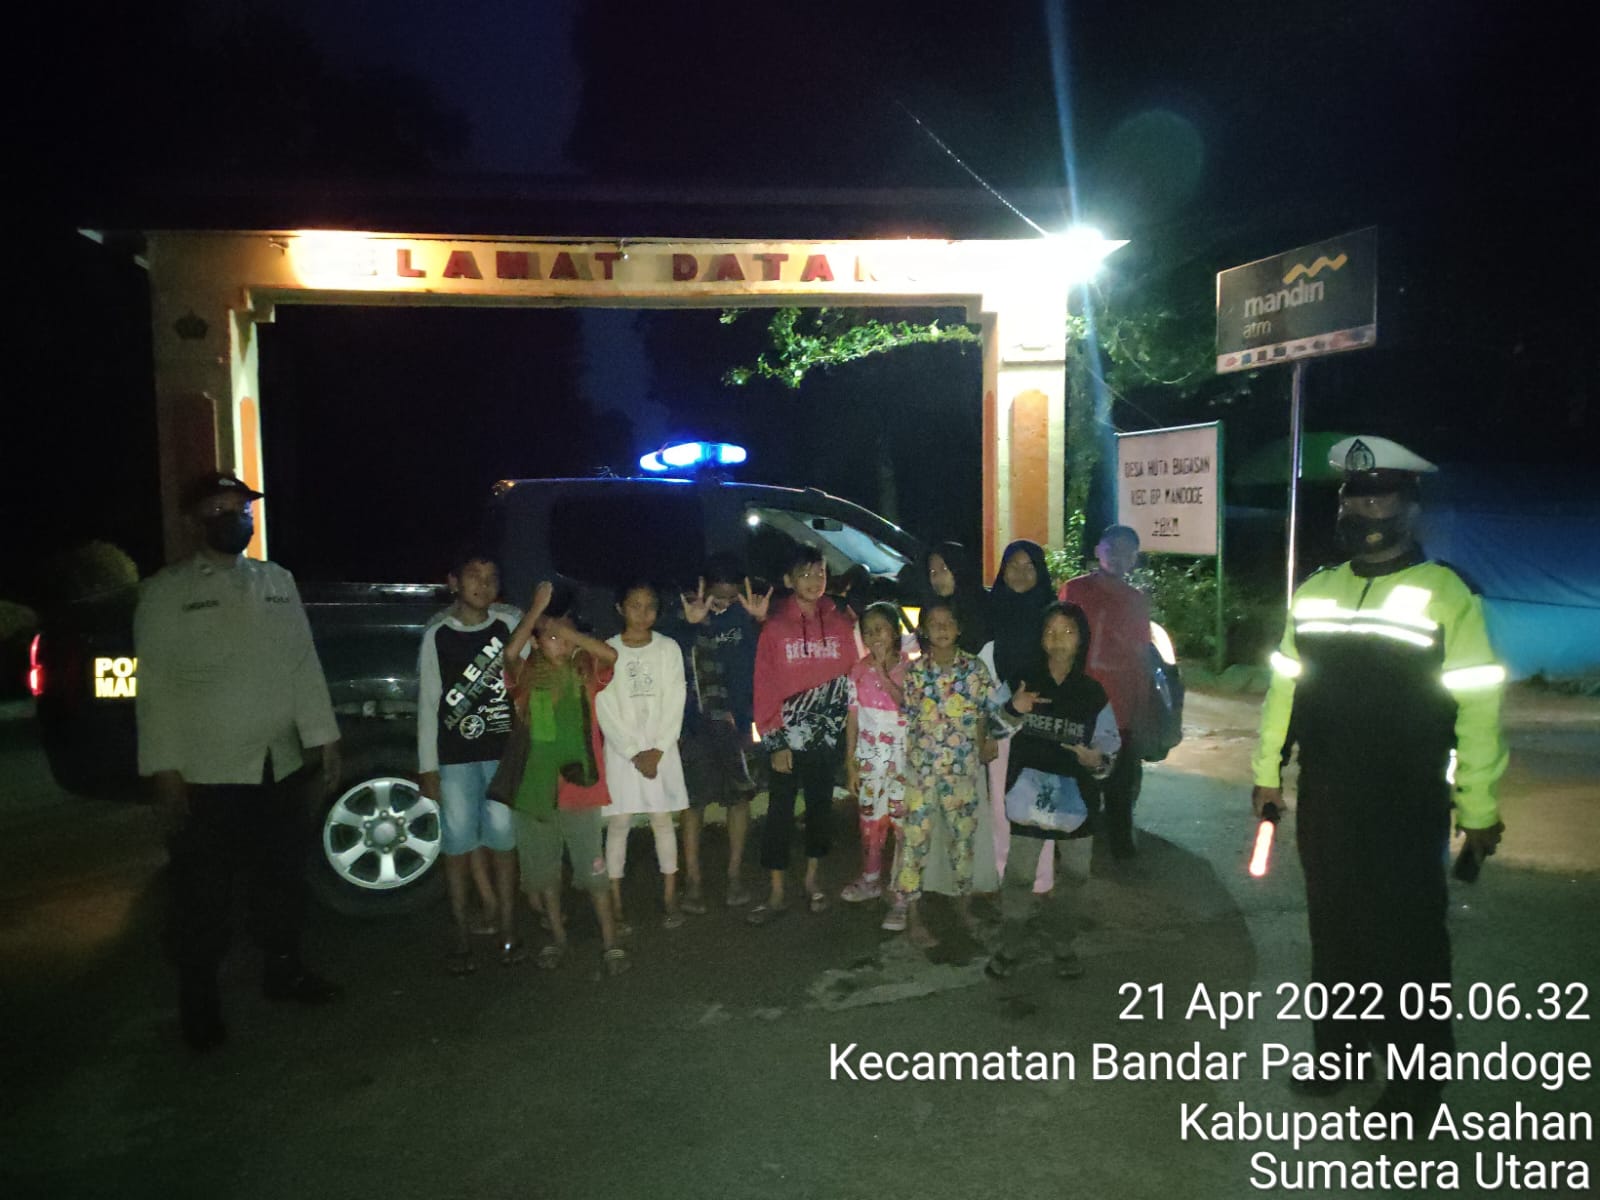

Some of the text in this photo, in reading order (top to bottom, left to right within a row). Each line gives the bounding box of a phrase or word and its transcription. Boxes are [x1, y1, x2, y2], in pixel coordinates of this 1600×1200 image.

[1242, 320, 1272, 339] atm
[95, 657, 139, 678] PO
[445, 636, 504, 706] GLEAM
